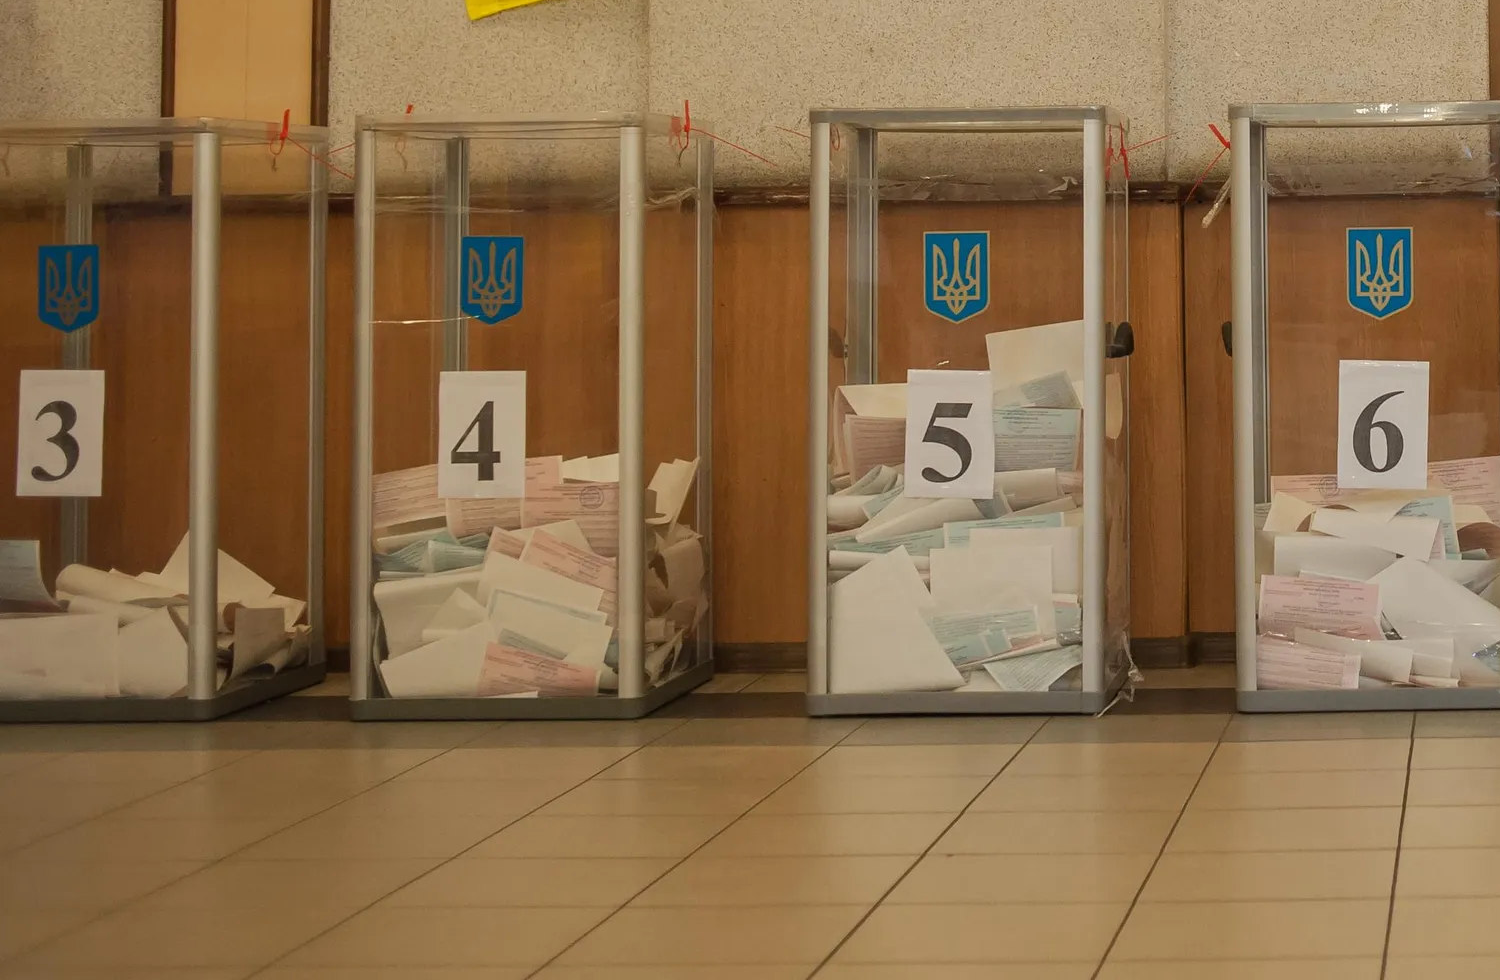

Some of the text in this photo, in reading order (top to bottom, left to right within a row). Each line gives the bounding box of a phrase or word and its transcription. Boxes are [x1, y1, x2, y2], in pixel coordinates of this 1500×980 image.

[31, 400, 80, 482] 3
[450, 400, 502, 482] 4
[921, 402, 973, 483] 5
[1352, 390, 1405, 473] 6
